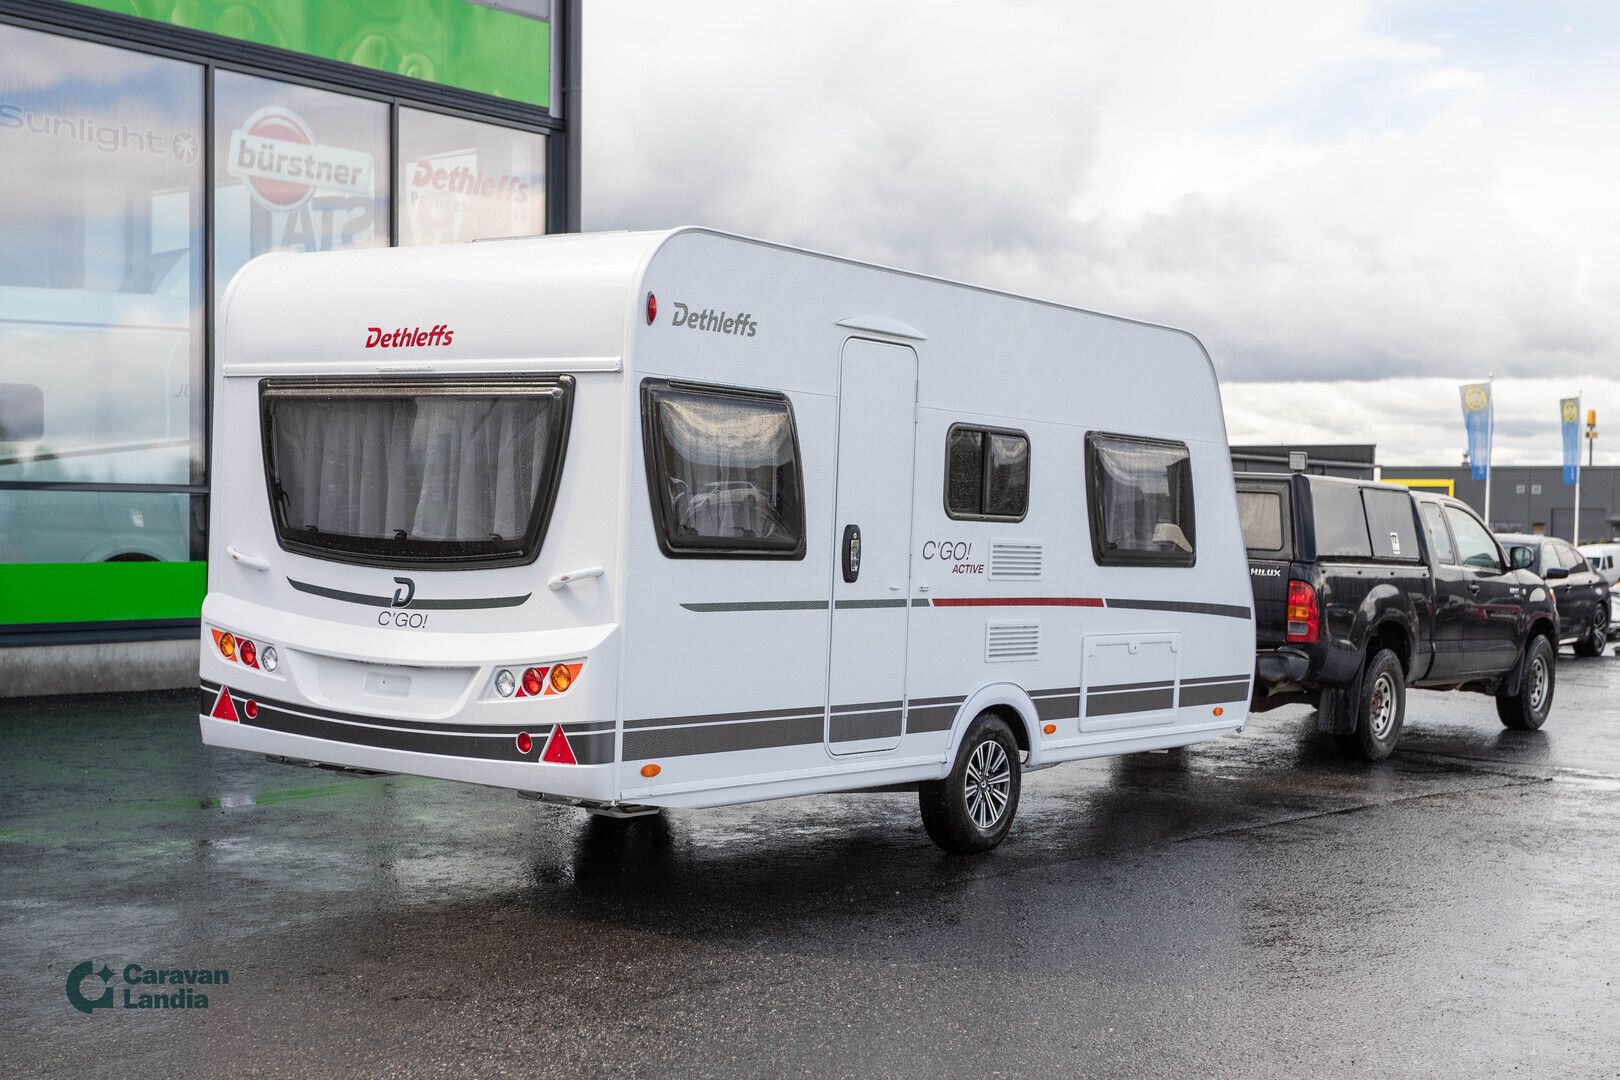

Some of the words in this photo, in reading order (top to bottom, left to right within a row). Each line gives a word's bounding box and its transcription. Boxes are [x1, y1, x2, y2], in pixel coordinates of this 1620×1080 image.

[0, 104, 164, 154] Sunlight
[237, 139, 363, 187] bürstner
[410, 159, 530, 204] Dethleffs
[671, 301, 758, 338] Dethleffs
[365, 324, 454, 348] Dethleffs
[922, 540, 973, 561] C'GO!
[951, 563, 985, 575] ACTIVE
[1250, 567, 1281, 577] HILUX
[377, 610, 429, 629] C'GO!
